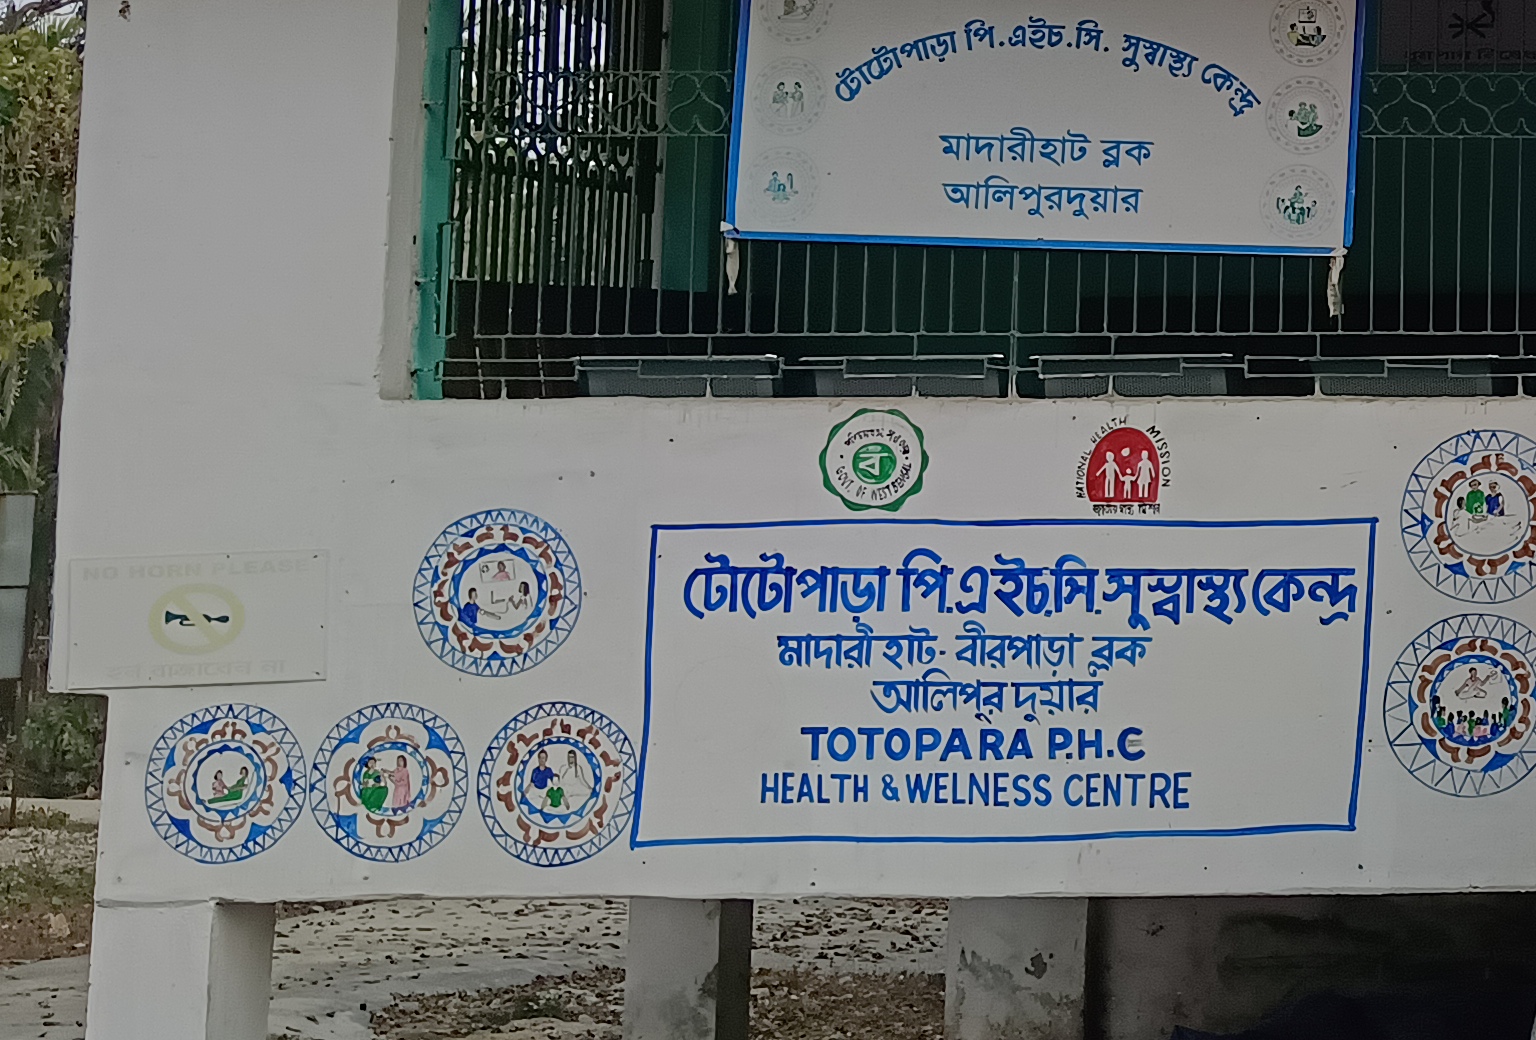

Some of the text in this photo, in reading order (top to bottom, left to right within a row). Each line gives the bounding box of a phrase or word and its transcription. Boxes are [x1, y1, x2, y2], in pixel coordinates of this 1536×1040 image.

[1201, 63, 1262, 117] কেন্দ্র
[938, 126, 1155, 168] মাদারীহাট ব্লক
[941, 174, 1144, 221] আলিপুরদুয়ার
[1075, 413, 1171, 499] NATIONAL HEALTH MISSION
[83, 559, 310, 581] NO HORN PLEASE
[683, 551, 892, 624] টোটোপাড়া
[1251, 567, 1359, 626] কেন্দ্র
[800, 726, 1147, 763] TOTOPARA P.H.C
[760, 771, 1193, 810] HEALTH & WELNESS CENTRE
